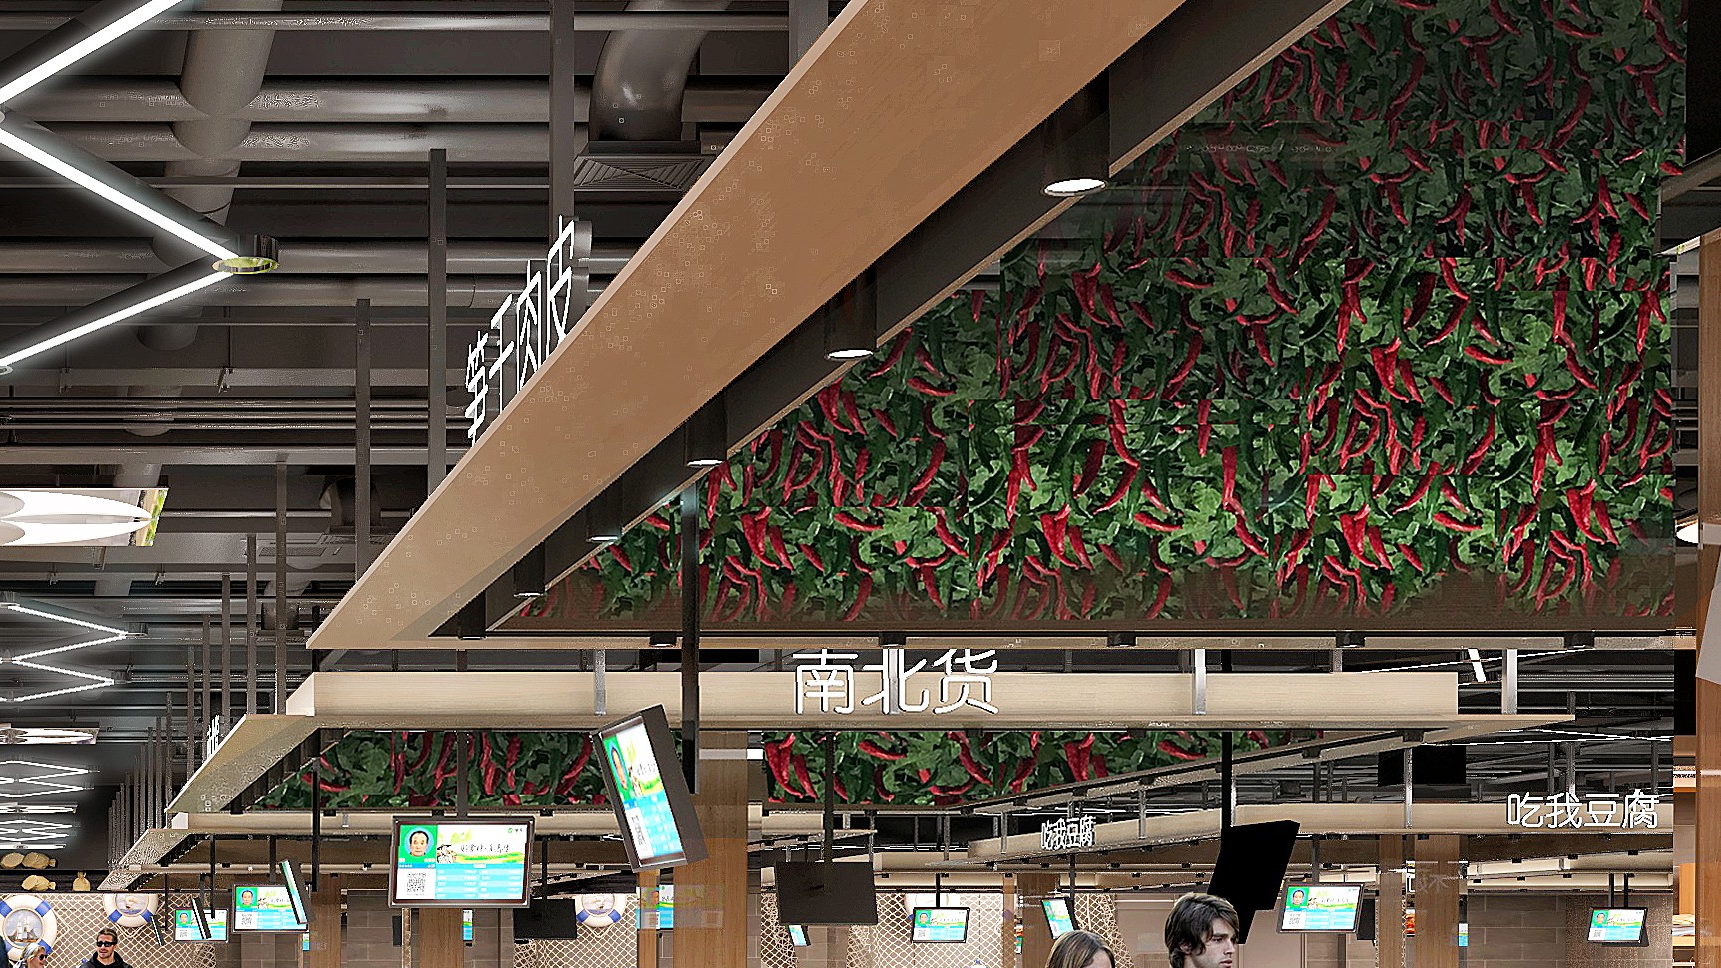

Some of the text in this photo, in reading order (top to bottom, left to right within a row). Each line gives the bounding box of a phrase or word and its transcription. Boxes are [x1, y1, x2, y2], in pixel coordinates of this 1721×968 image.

[792, 648, 999, 714] 南北货
[1506, 788, 1660, 829] 吃我豆腐
